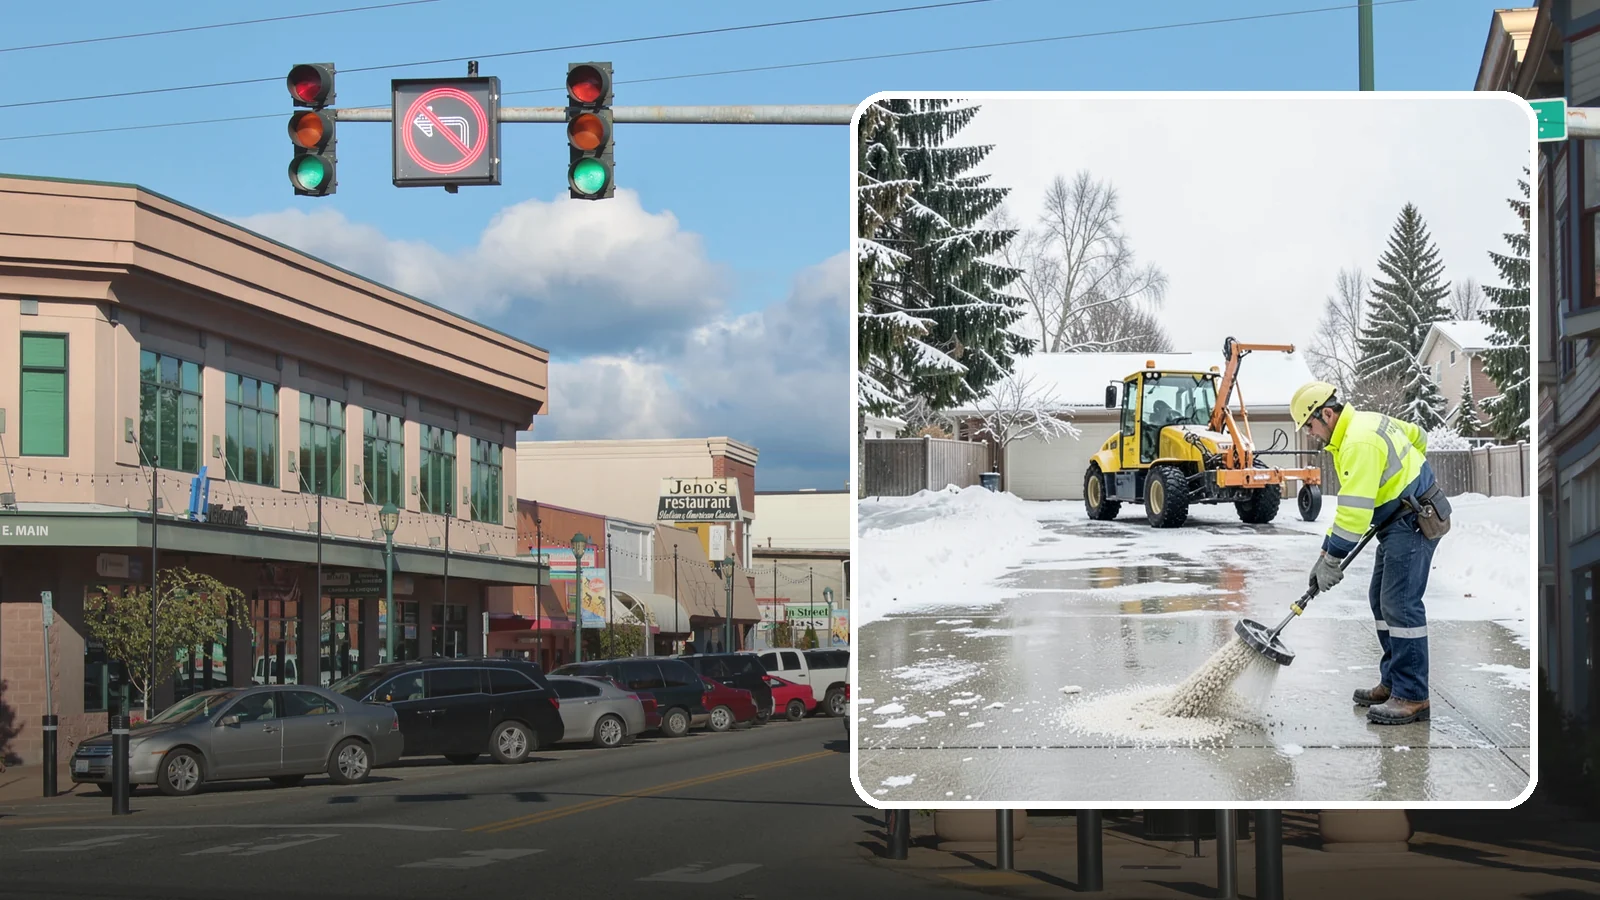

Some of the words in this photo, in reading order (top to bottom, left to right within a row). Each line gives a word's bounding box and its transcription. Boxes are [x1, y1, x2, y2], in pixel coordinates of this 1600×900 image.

[669, 480, 728, 495] Jeno's
[665, 496, 731, 509] restaurant
[686, 510, 715, 520] American
[715, 510, 738, 519] Cuisine
[2, 525, 12, 536] E.
[15, 525, 49, 536] MAIN
[797, 607, 828, 617] Street
